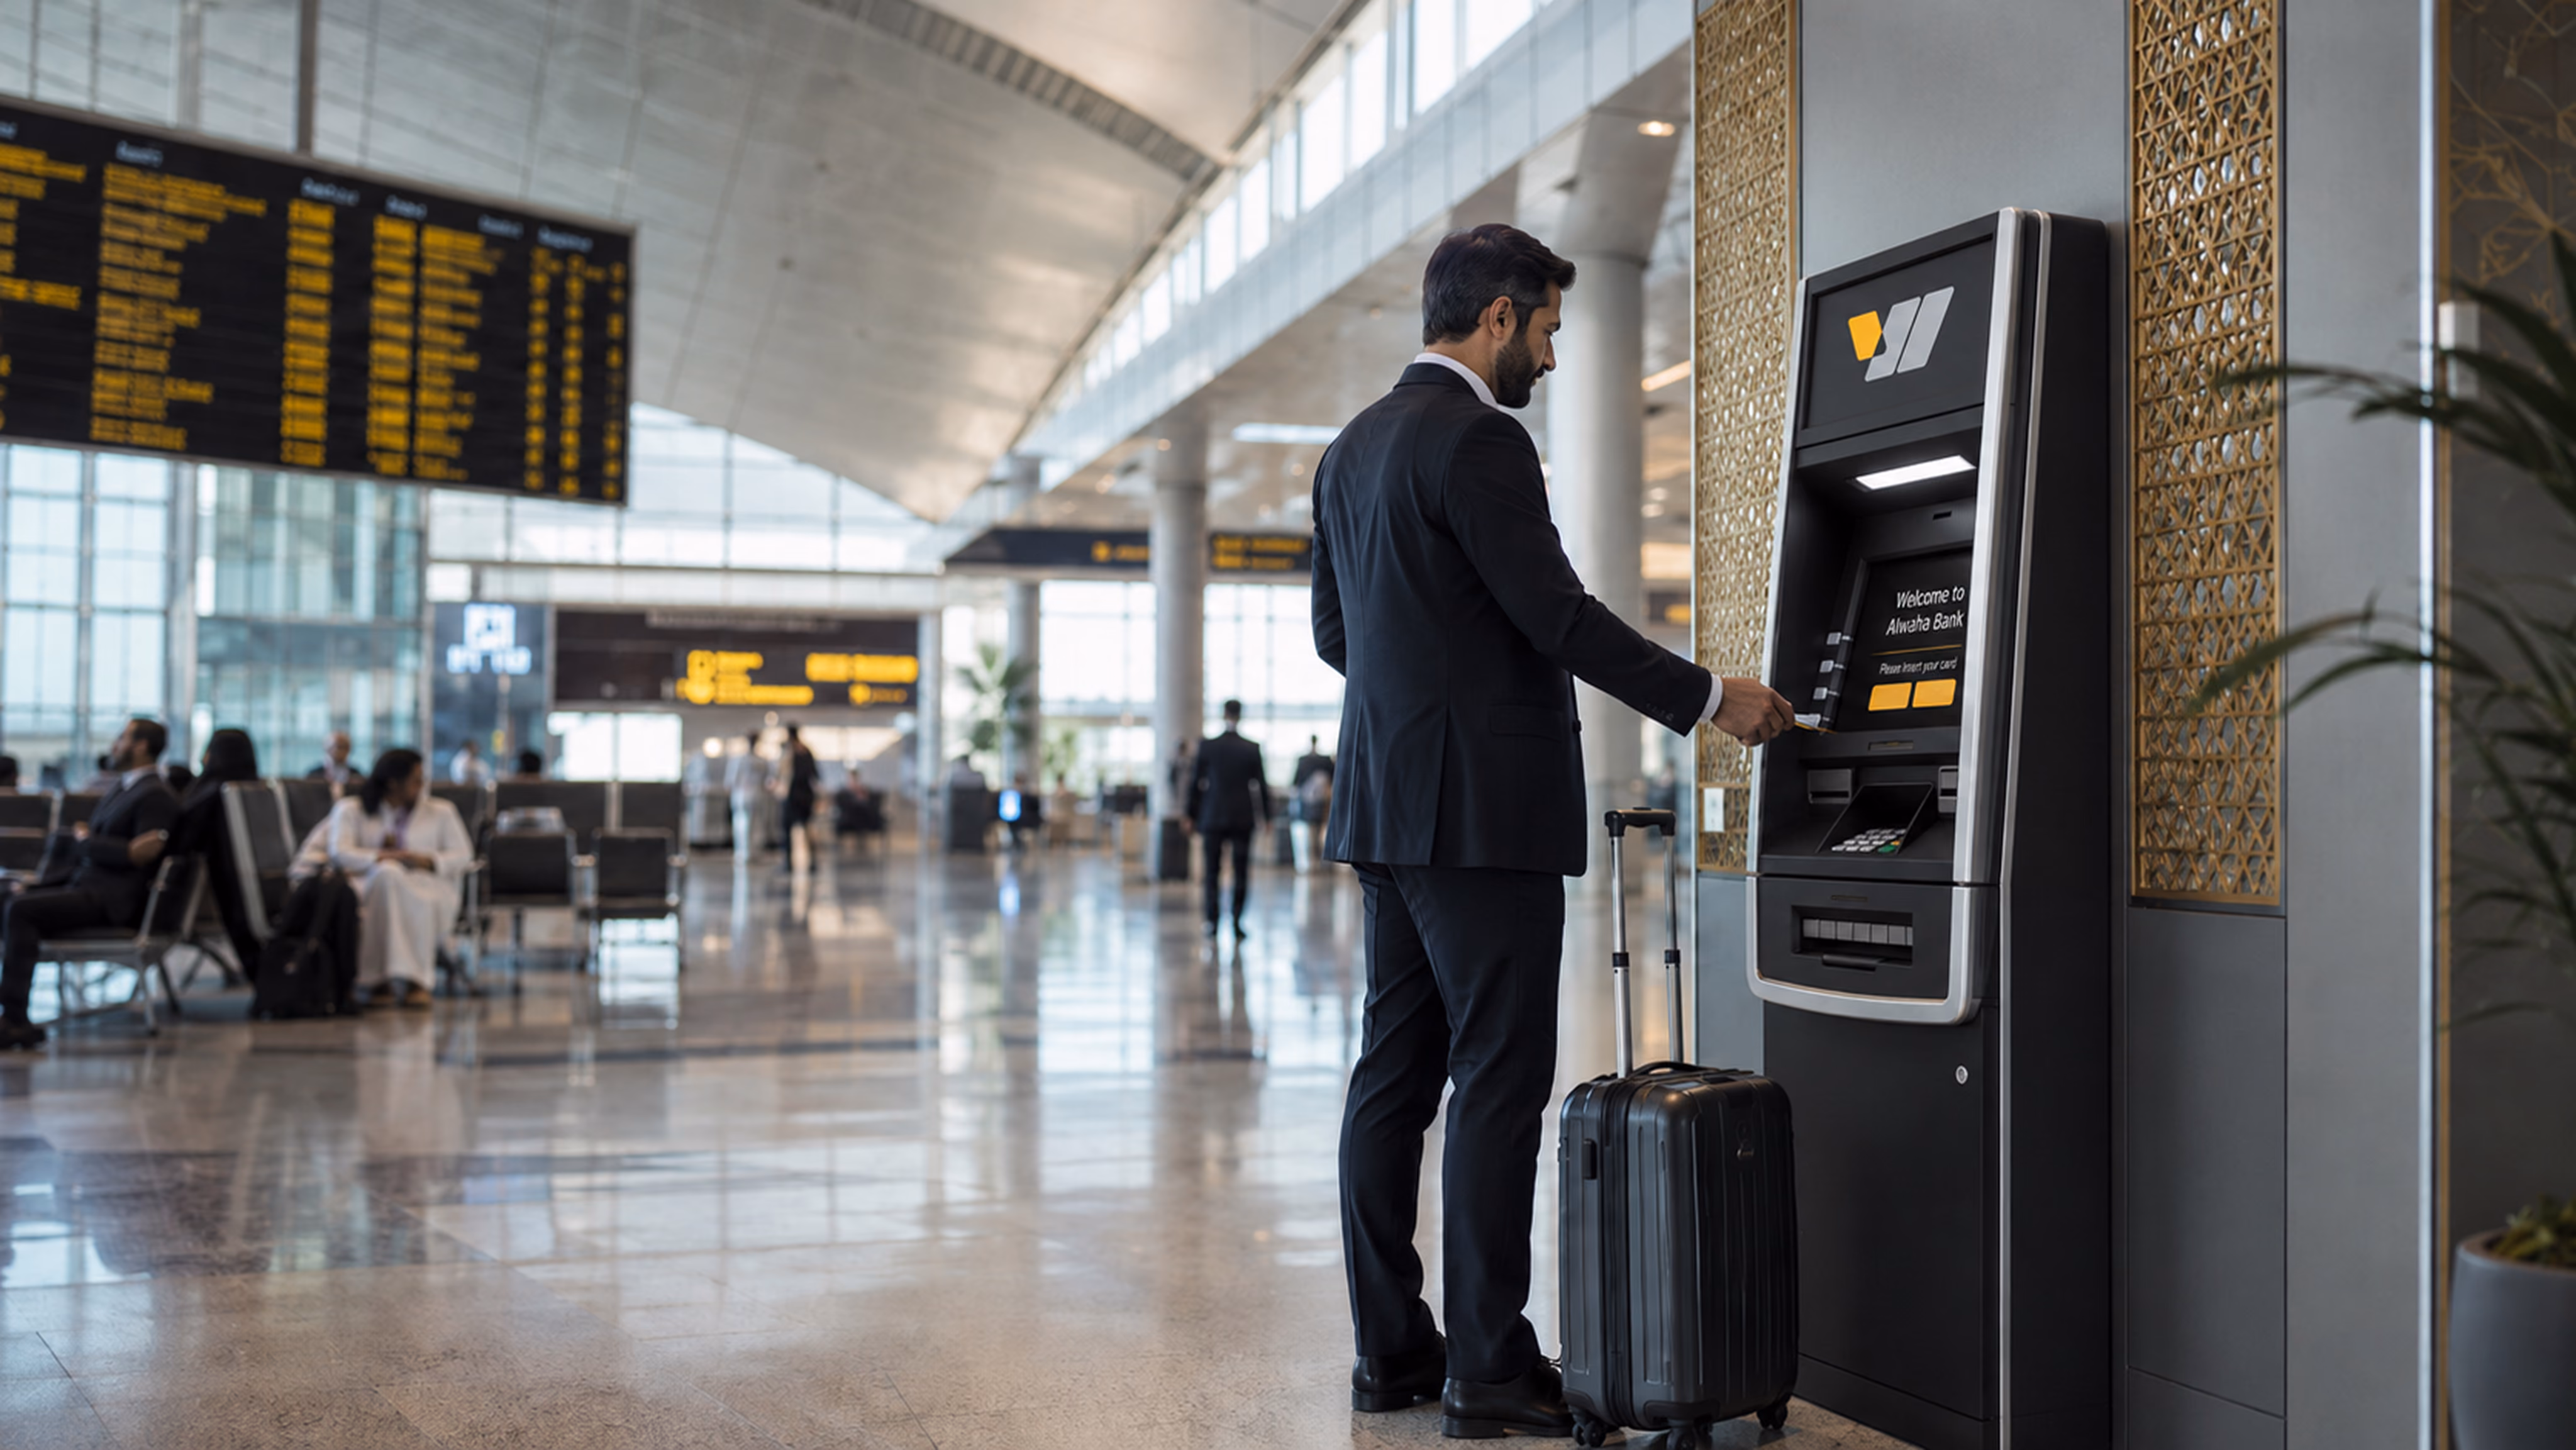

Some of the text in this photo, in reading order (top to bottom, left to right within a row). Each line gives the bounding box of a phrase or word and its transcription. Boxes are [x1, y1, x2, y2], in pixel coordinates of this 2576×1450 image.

[1897, 586, 1965, 608] Welcome to
[1885, 610, 1965, 635] Alwaha Bank
[1922, 661, 1940, 674] your
[1940, 656, 1958, 670] card
